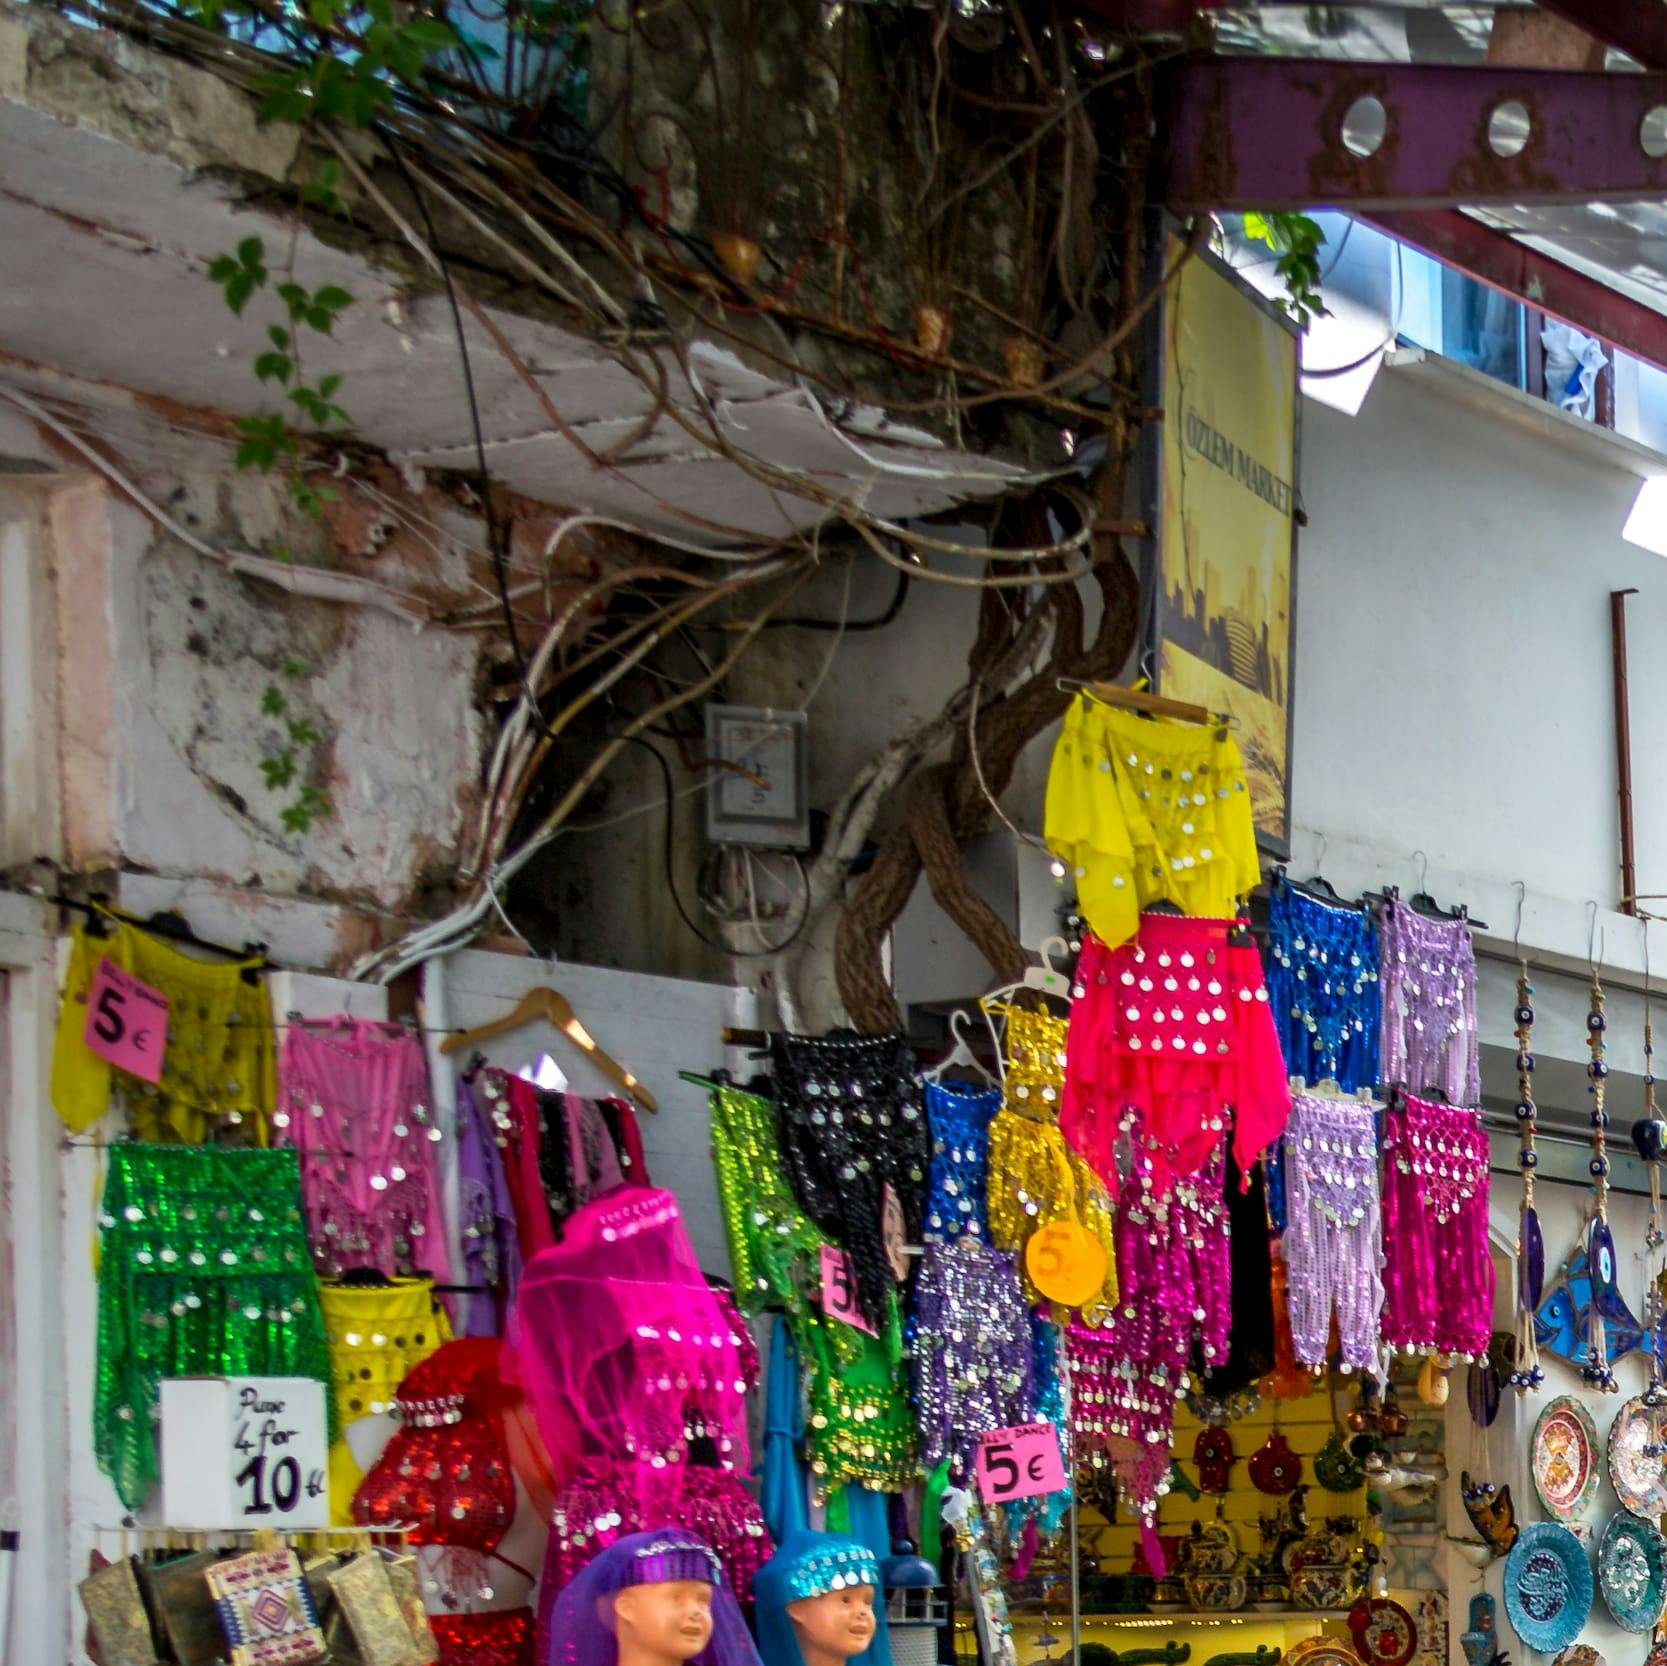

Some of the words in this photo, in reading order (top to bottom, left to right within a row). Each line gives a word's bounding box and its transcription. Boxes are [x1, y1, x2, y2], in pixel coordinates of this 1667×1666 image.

[1236, 447, 1293, 518] MARKET
[95, 987, 126, 1044] 5
[234, 1421, 256, 1456] 4
[257, 1418, 301, 1457] for
[235, 1455, 301, 1516] 10
[985, 1443, 1020, 1494] 5
